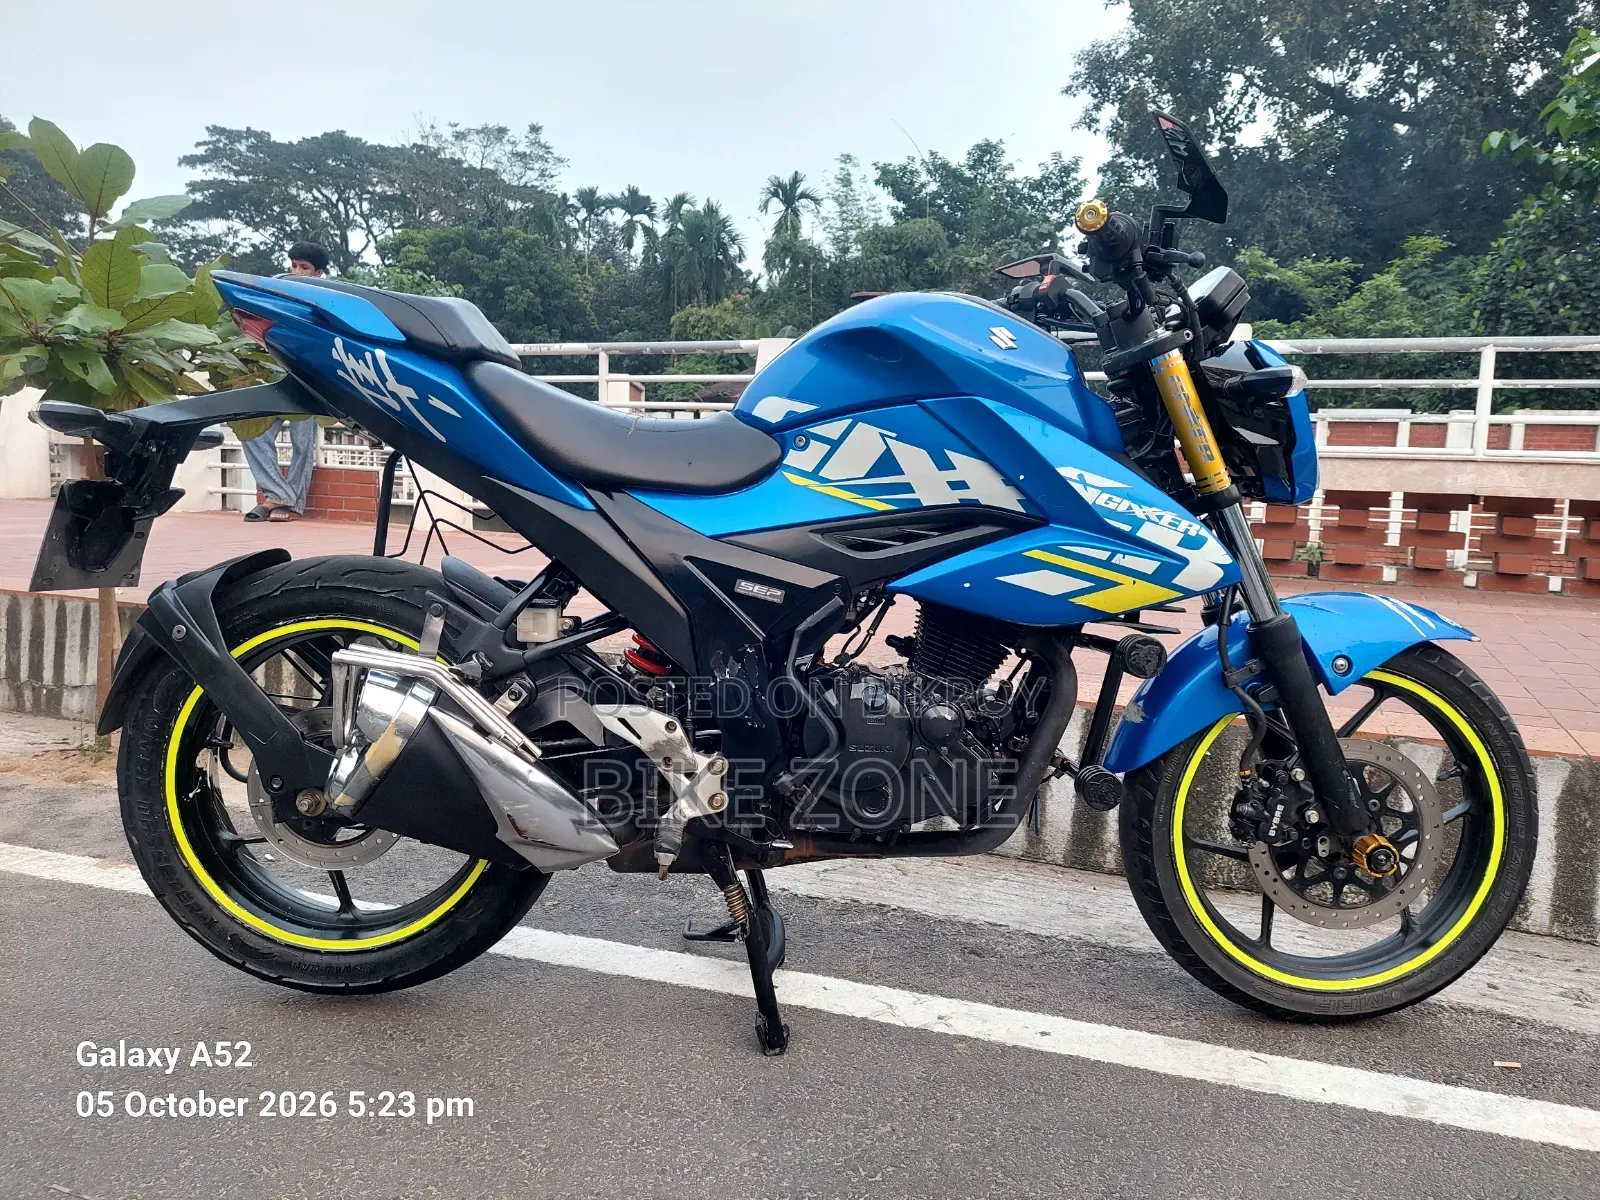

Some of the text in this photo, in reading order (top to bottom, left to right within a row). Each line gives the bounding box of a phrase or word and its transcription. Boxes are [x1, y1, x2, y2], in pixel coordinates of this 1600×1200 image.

[1095, 491, 1202, 537] GIXXER
[738, 581, 782, 596] SEP
[1267, 803, 1285, 837] BYBRE
